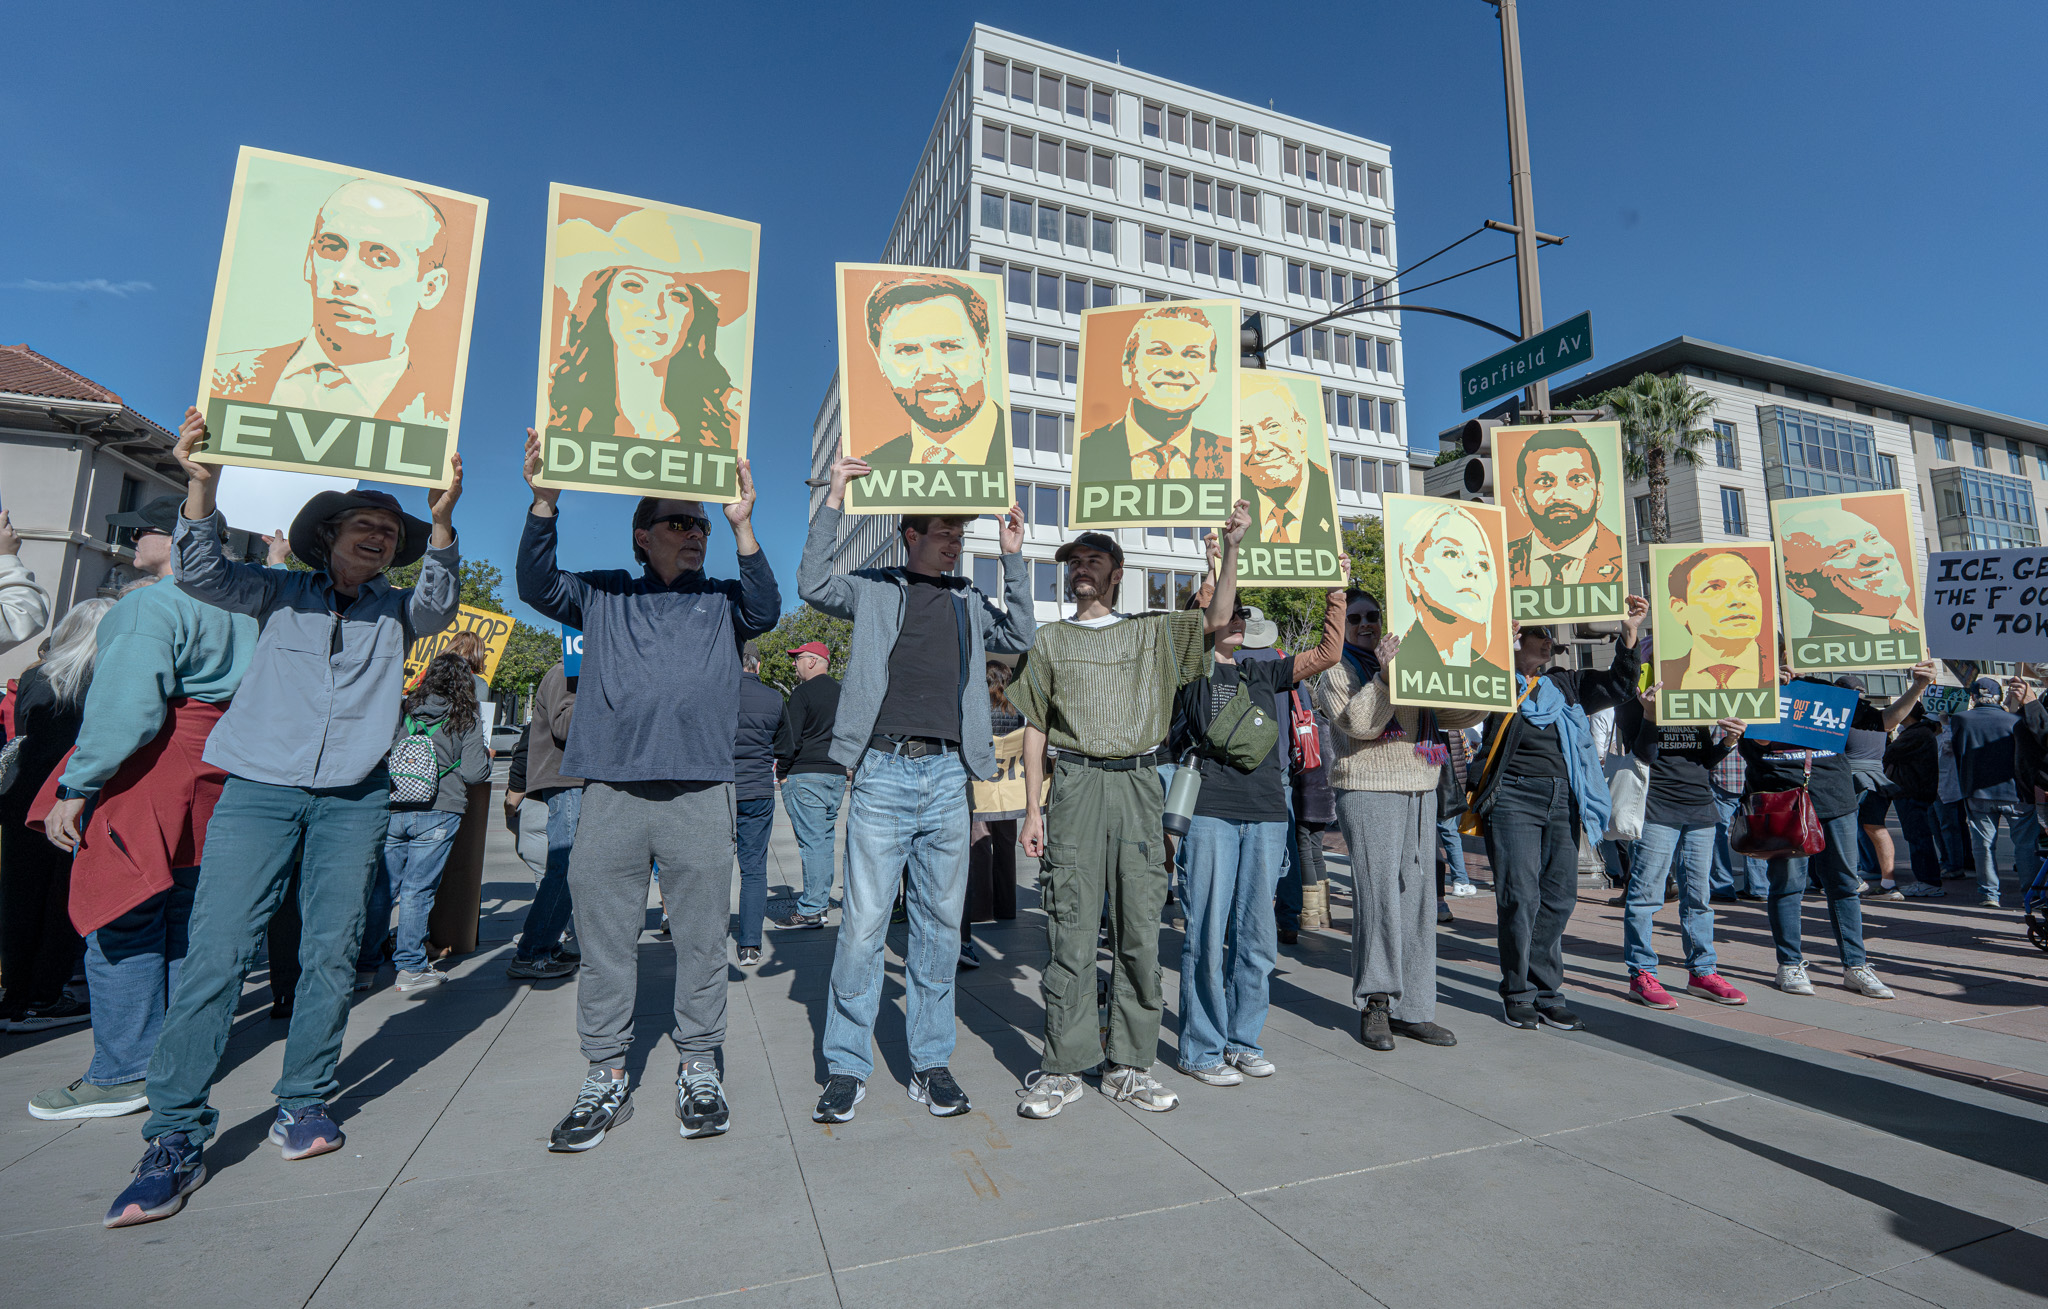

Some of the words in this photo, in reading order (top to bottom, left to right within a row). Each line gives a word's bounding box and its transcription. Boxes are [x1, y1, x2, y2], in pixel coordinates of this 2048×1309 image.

[1468, 347, 1545, 395] Garfield
[1557, 334, 1581, 357] Av
[220, 404, 431, 475] EVIL
[549, 437, 735, 488] DECEIT
[858, 470, 1005, 498] WRATH
[1083, 483, 1225, 518] PRIDE
[1937, 557, 2003, 582] ICE,
[1513, 584, 1618, 617] RUIN
[1934, 588, 1976, 606] THE
[1951, 613, 1983, 634] OF
[1797, 639, 1918, 664] CRUEL
[1401, 669, 1507, 700] MALICE
[1668, 692, 1768, 718] ENVY
[1793, 699, 1811, 711] OUT
[1793, 711, 1805, 721] OF
[1927, 698, 1960, 714] SGV
[1664, 733, 1679, 741] BUT
[1681, 733, 1696, 741] THE
